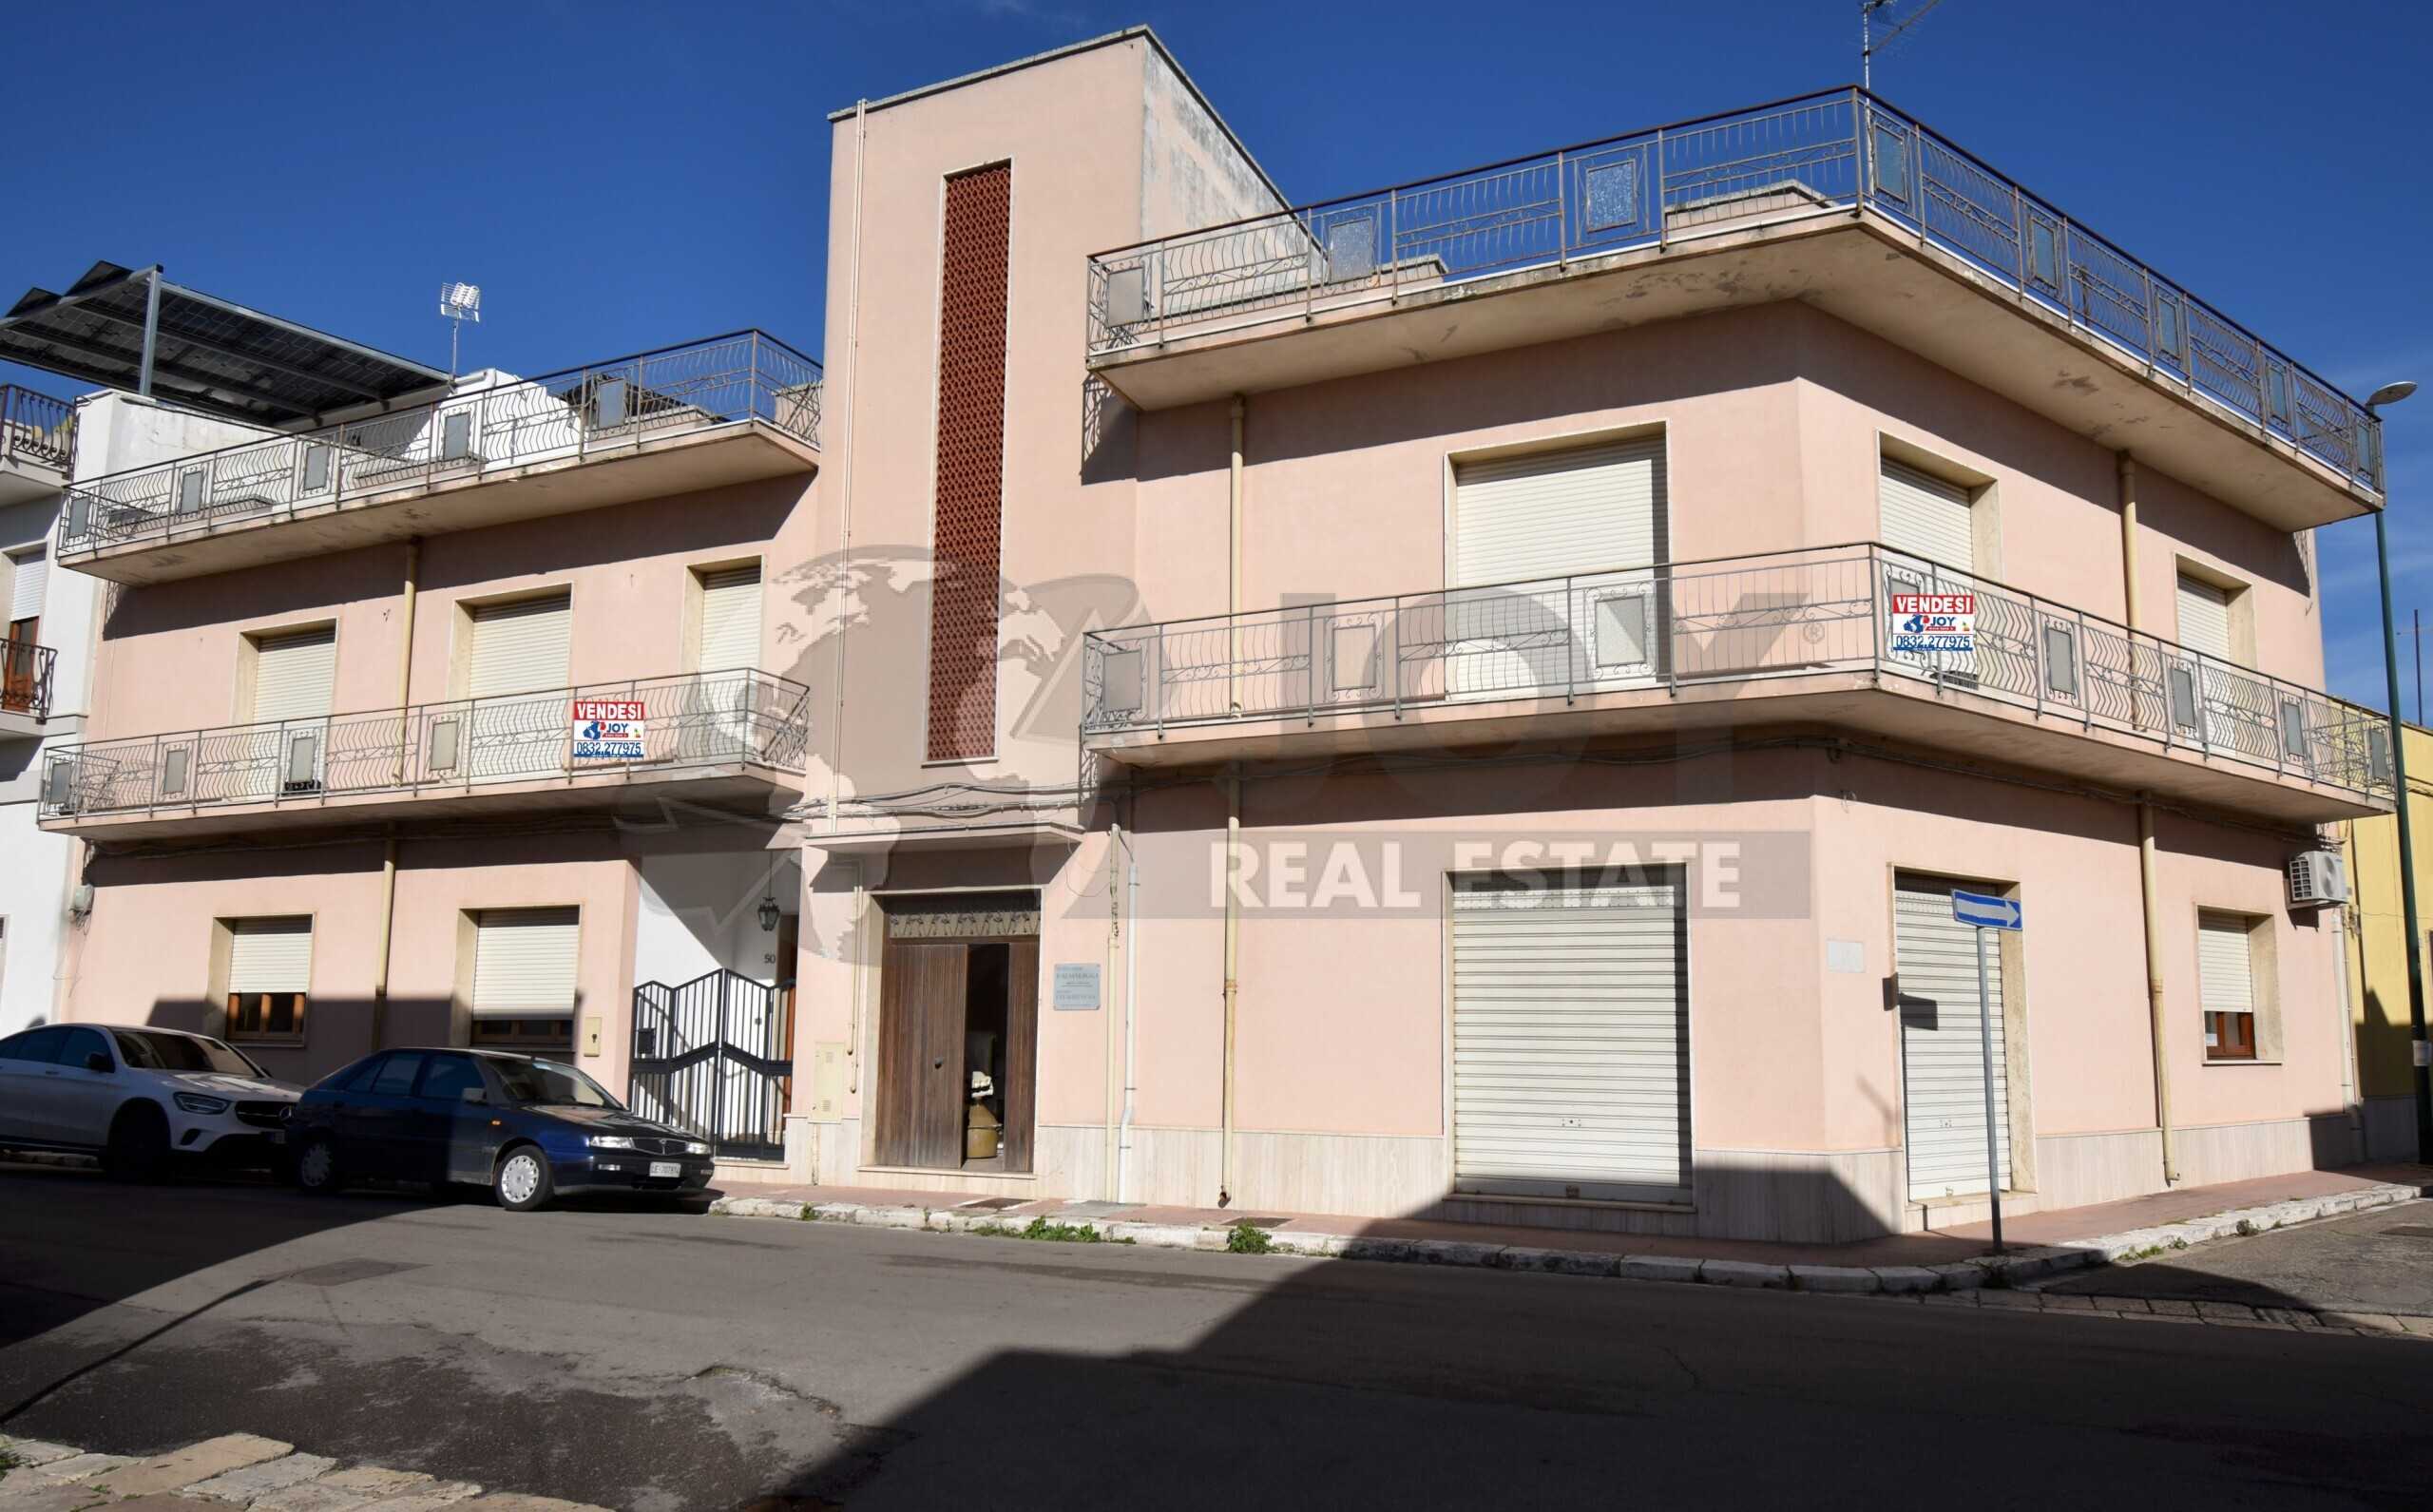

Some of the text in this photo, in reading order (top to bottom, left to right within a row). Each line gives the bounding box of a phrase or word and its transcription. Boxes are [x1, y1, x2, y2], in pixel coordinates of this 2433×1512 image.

[1896, 597, 1971, 613] VENDESI
[1930, 616, 1955, 626] JOY
[1896, 636, 1970, 648] 0832.277975
[577, 703, 642, 719] VENDESI
[606, 722, 628, 733] JOY
[576, 742, 642, 755] 0832.277975
[764, 953, 776, 965] 50
